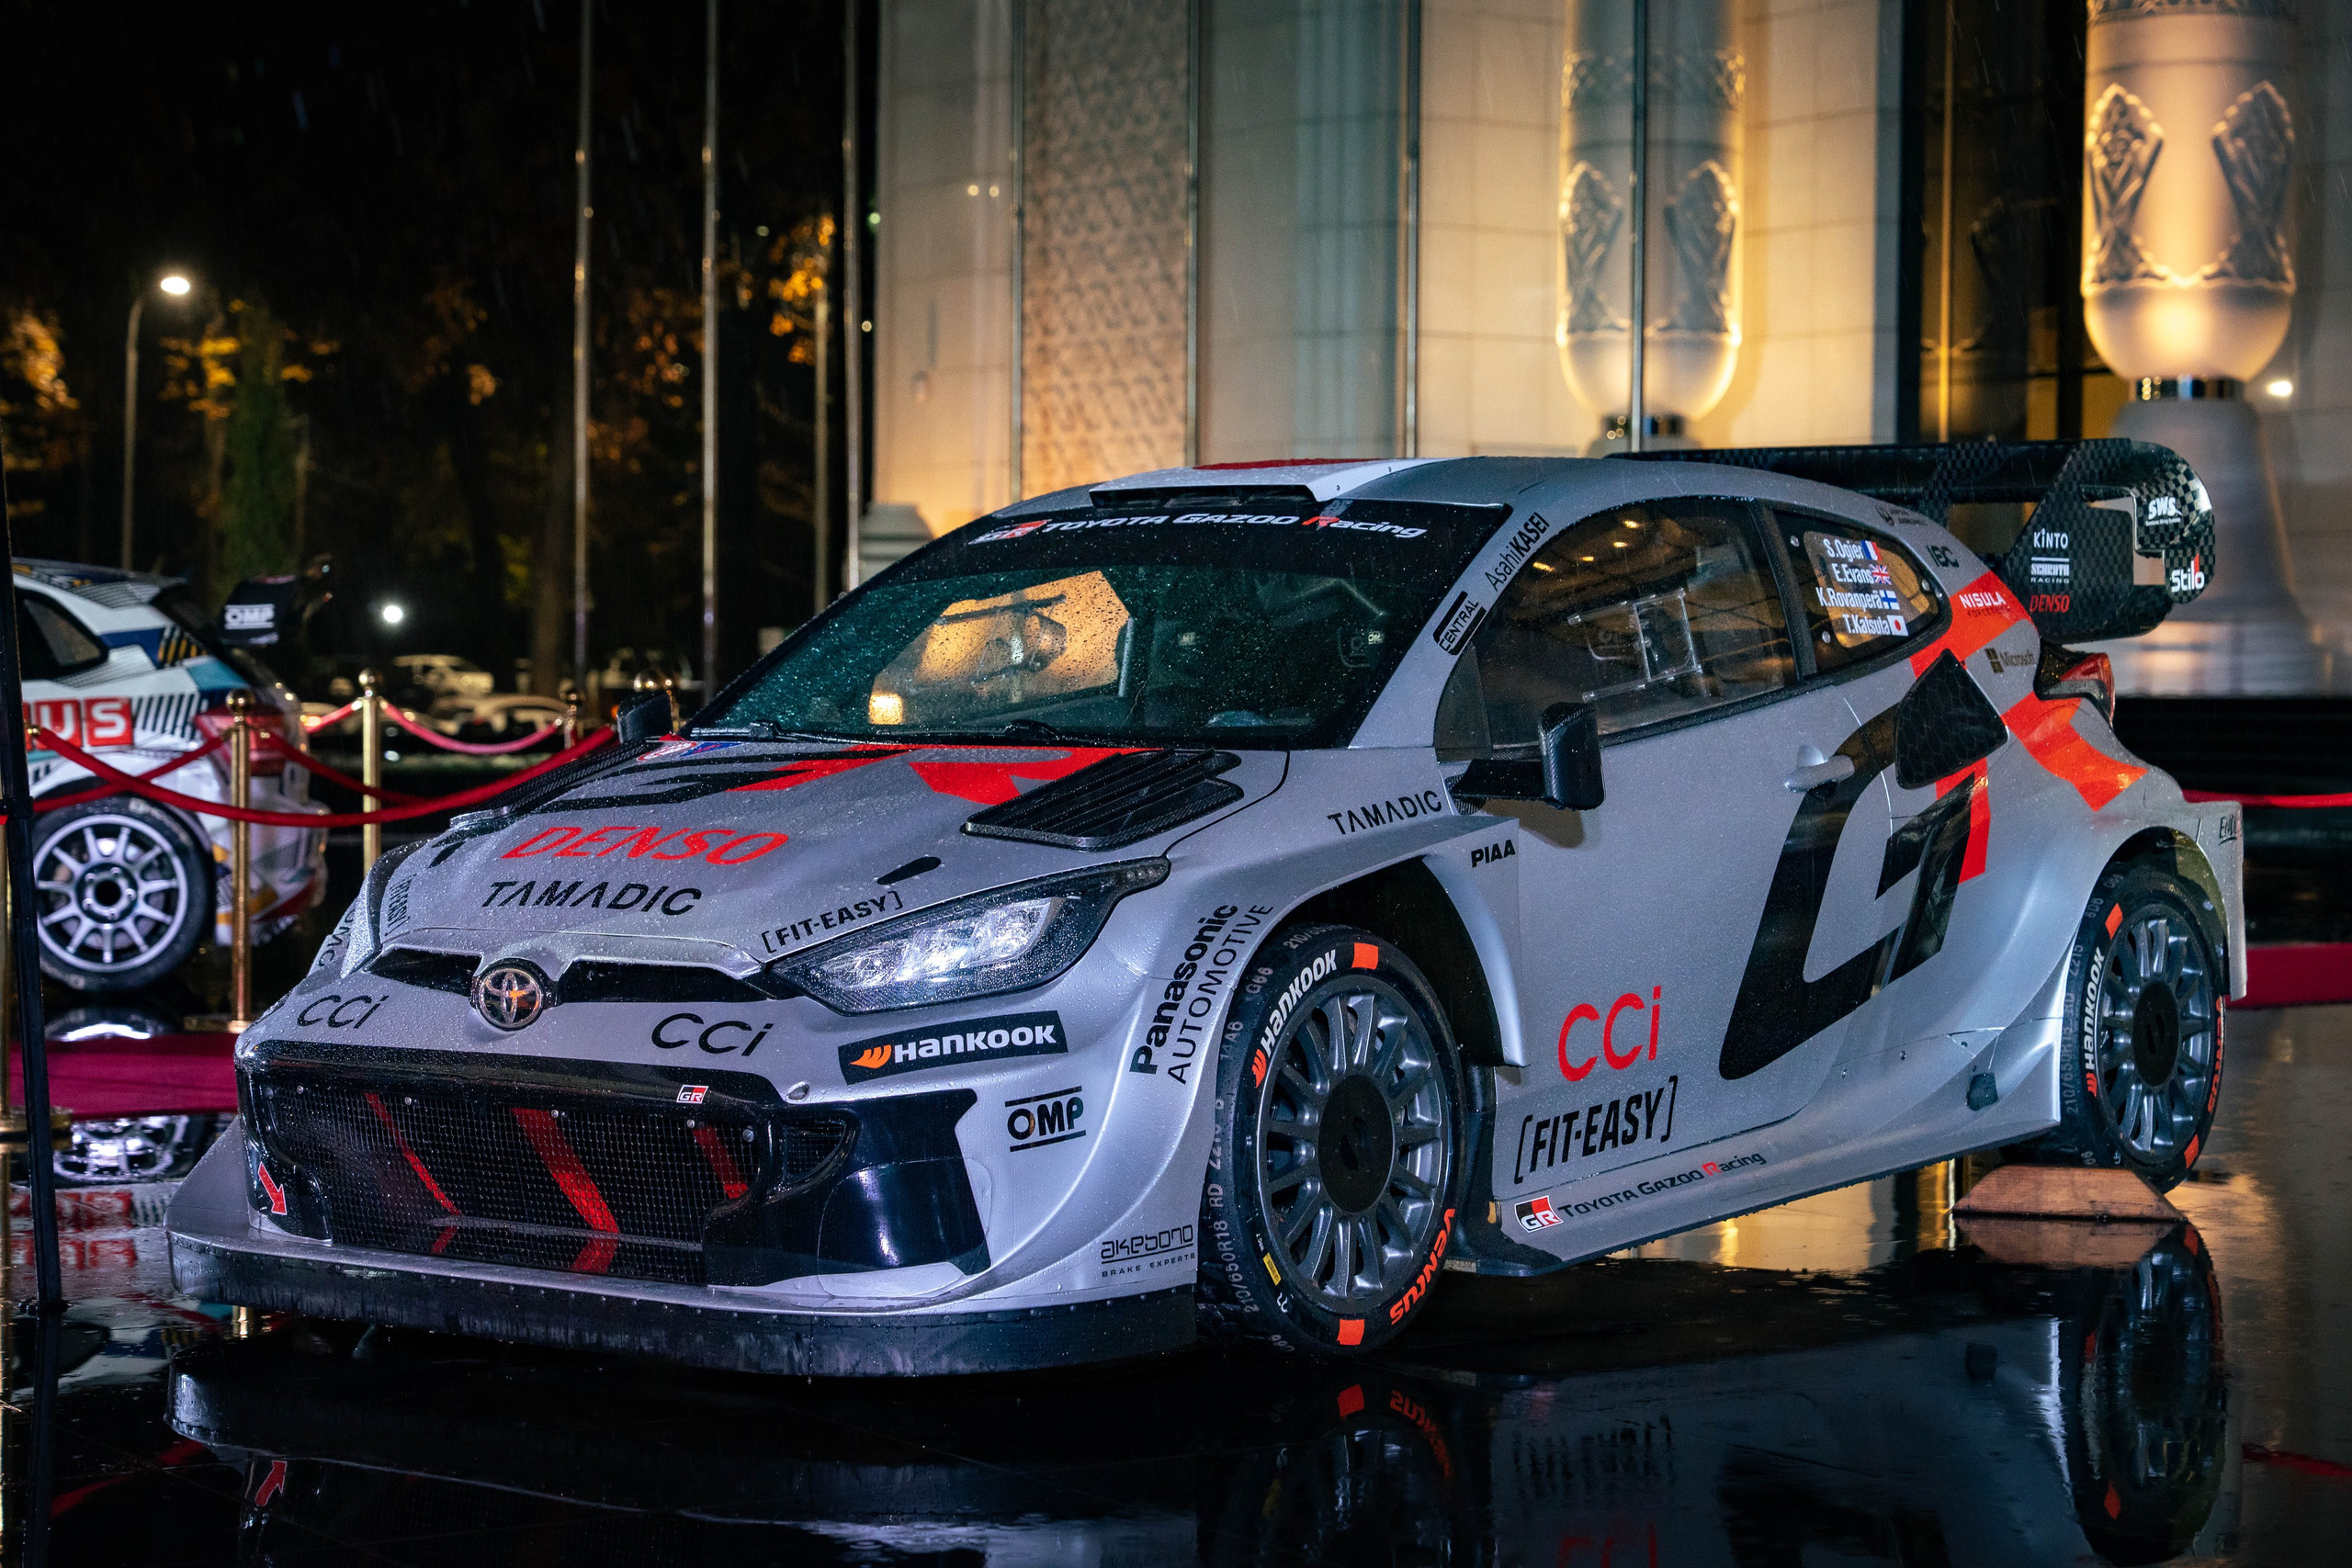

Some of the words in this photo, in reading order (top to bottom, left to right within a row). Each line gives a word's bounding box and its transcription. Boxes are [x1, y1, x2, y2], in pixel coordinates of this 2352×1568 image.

[1042, 515, 1170, 533] TOYOTA
[1172, 513, 1300, 525] GAZOO
[1301, 515, 1428, 538] Racing
[2148, 496, 2178, 520] SWS
[1485, 512, 1550, 592] AsahiKASEI
[1823, 537, 1864, 562] S.Ogier
[1831, 562, 1875, 584] E.Evans
[2171, 554, 2205, 592] Stilo
[1815, 586, 1883, 612] K.Rovanperä
[1959, 592, 2007, 609] NISULA
[2029, 594, 2070, 613] DENSO
[1439, 600, 1479, 652] CENTRAL
[1842, 614, 1891, 636] T.Katsuta
[1327, 790, 1442, 835] TAMADIC
[500, 827, 789, 865] DENSO
[1471, 839, 1516, 868] PIAA
[481, 880, 702, 916] TAMADIC
[1129, 905, 1238, 1075] Panasonic
[1167, 905, 1274, 1085] AUTOMOTIVE
[296, 995, 390, 1029] CCi
[650, 1012, 774, 1056] CCi
[1557, 985, 1661, 1082] CCi
[1007, 1096, 1084, 1141] OMP
[1557, 1189, 1639, 1218] TOYOTA
[1637, 1169, 1705, 1195] GAZOO
[1702, 1152, 1767, 1177] Racing
[1102, 1265, 1141, 1278] BRAKE
[1149, 1252, 1195, 1269] EXPERTS
